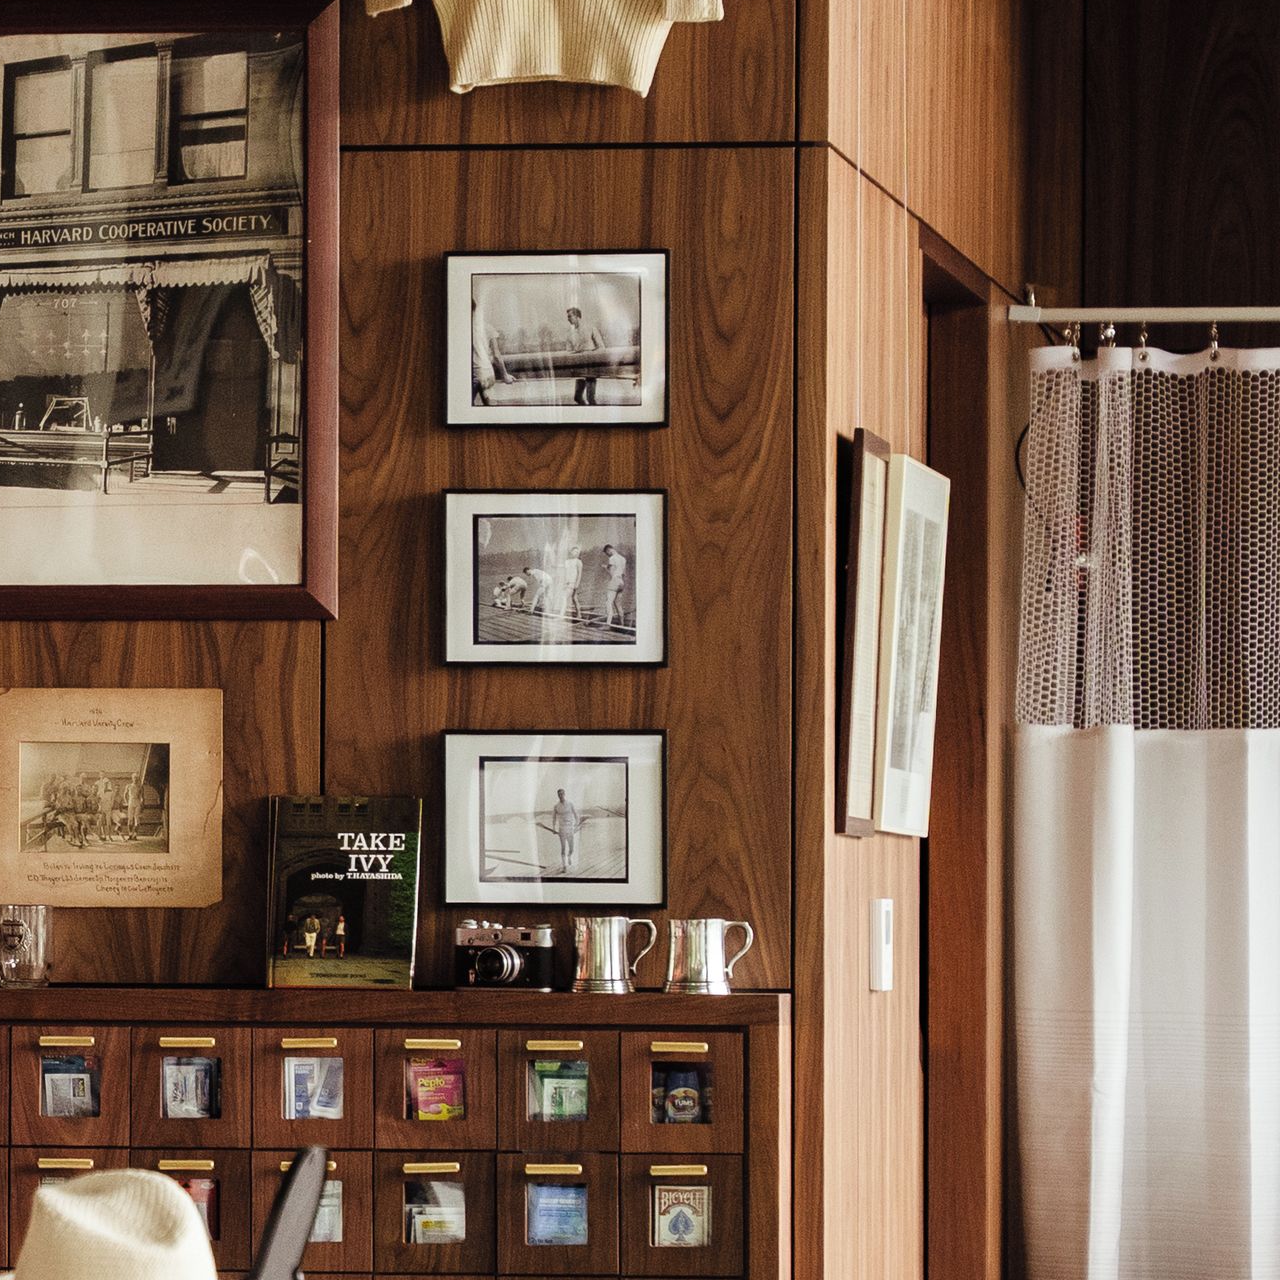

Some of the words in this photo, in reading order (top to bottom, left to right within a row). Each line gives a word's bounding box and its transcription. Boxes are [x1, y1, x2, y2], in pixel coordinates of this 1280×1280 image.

[21, 226, 93, 245] HARVARD
[98, 219, 197, 240] COOPERATIVE
[53, 297, 78, 309] 707
[337, 832, 406, 851] TAKE
[348, 854, 394, 872] IVY
[311, 872, 334, 880] photo
[334, 872, 345, 881] by
[419, 1077, 445, 1090] Pepto
[674, 1099, 694, 1107] TUMS
[660, 1191, 701, 1210] BICYCLE
